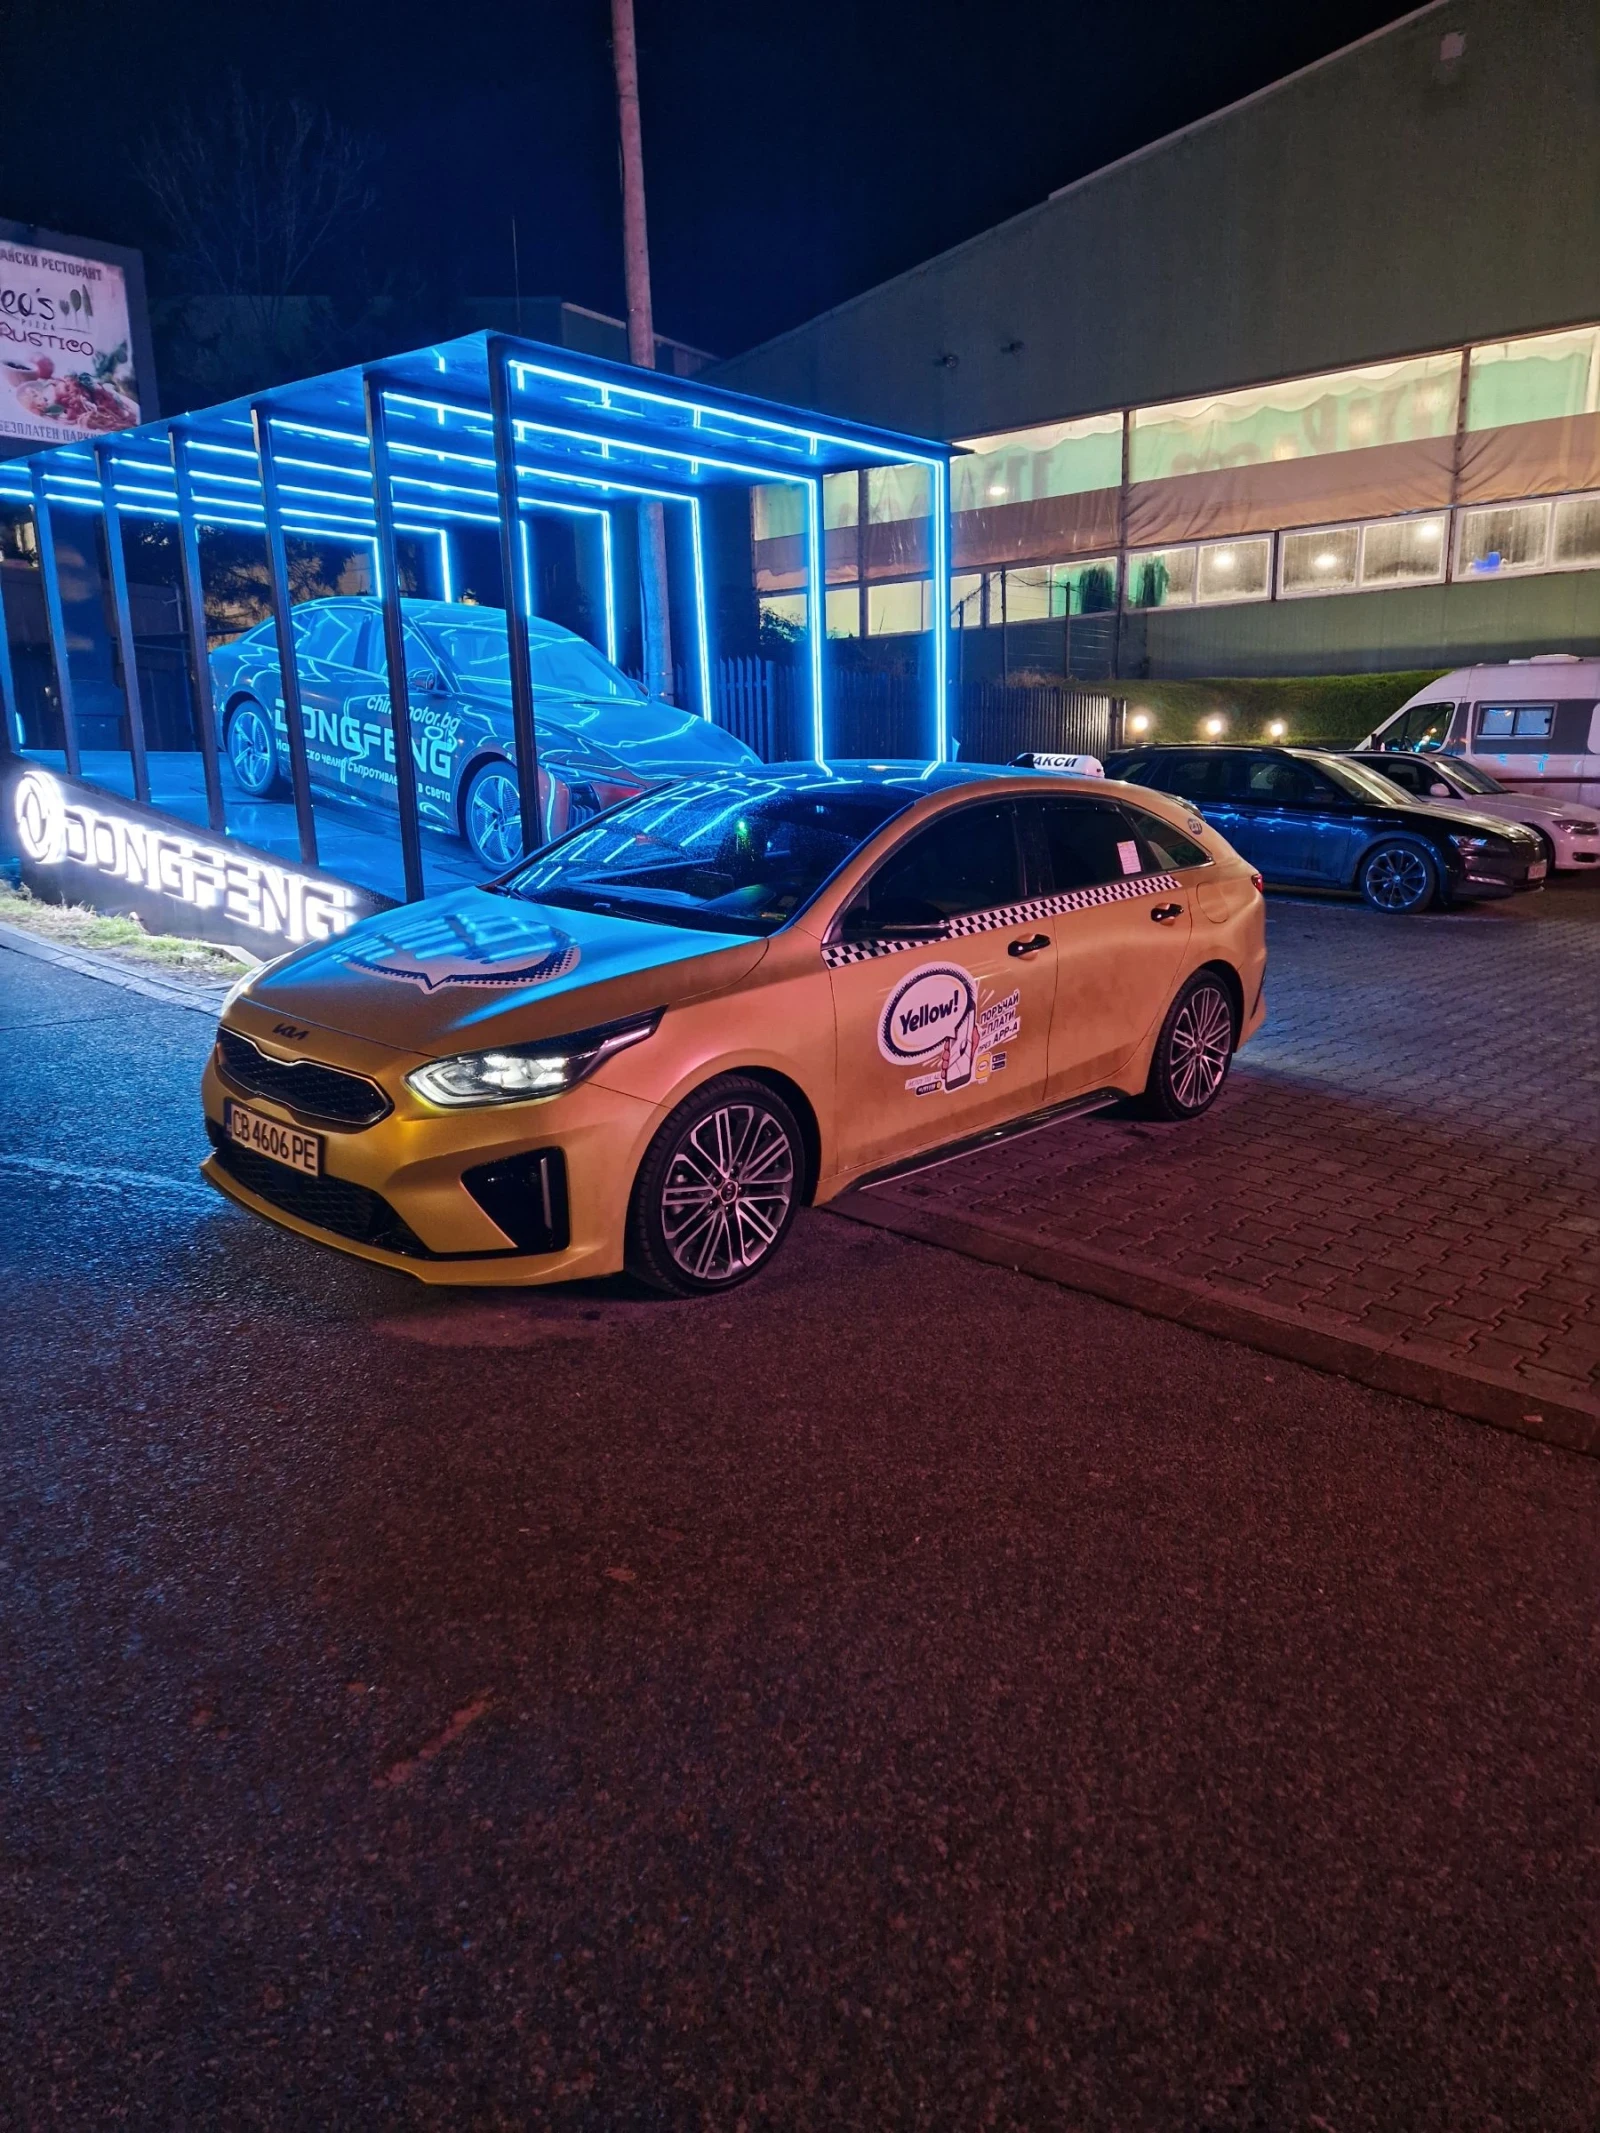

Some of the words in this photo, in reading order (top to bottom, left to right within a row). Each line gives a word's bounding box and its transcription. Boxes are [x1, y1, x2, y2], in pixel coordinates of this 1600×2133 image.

[41, 256, 103, 282] РЕСТОРАНТ
[0, 321, 94, 356] RUSTICO
[1033, 756, 1079, 767] АКСИ
[425, 785, 451, 802] света
[64, 803, 354, 943] DONGFENG
[899, 989, 959, 1035] Yellow!
[980, 991, 1019, 1024] ПОРЪЧАЙ
[987, 1011, 1014, 1034] ПЛАТИ
[233, 1109, 251, 1142] CB
[252, 1120, 289, 1159] 4606
[292, 1135, 316, 1170] PE
